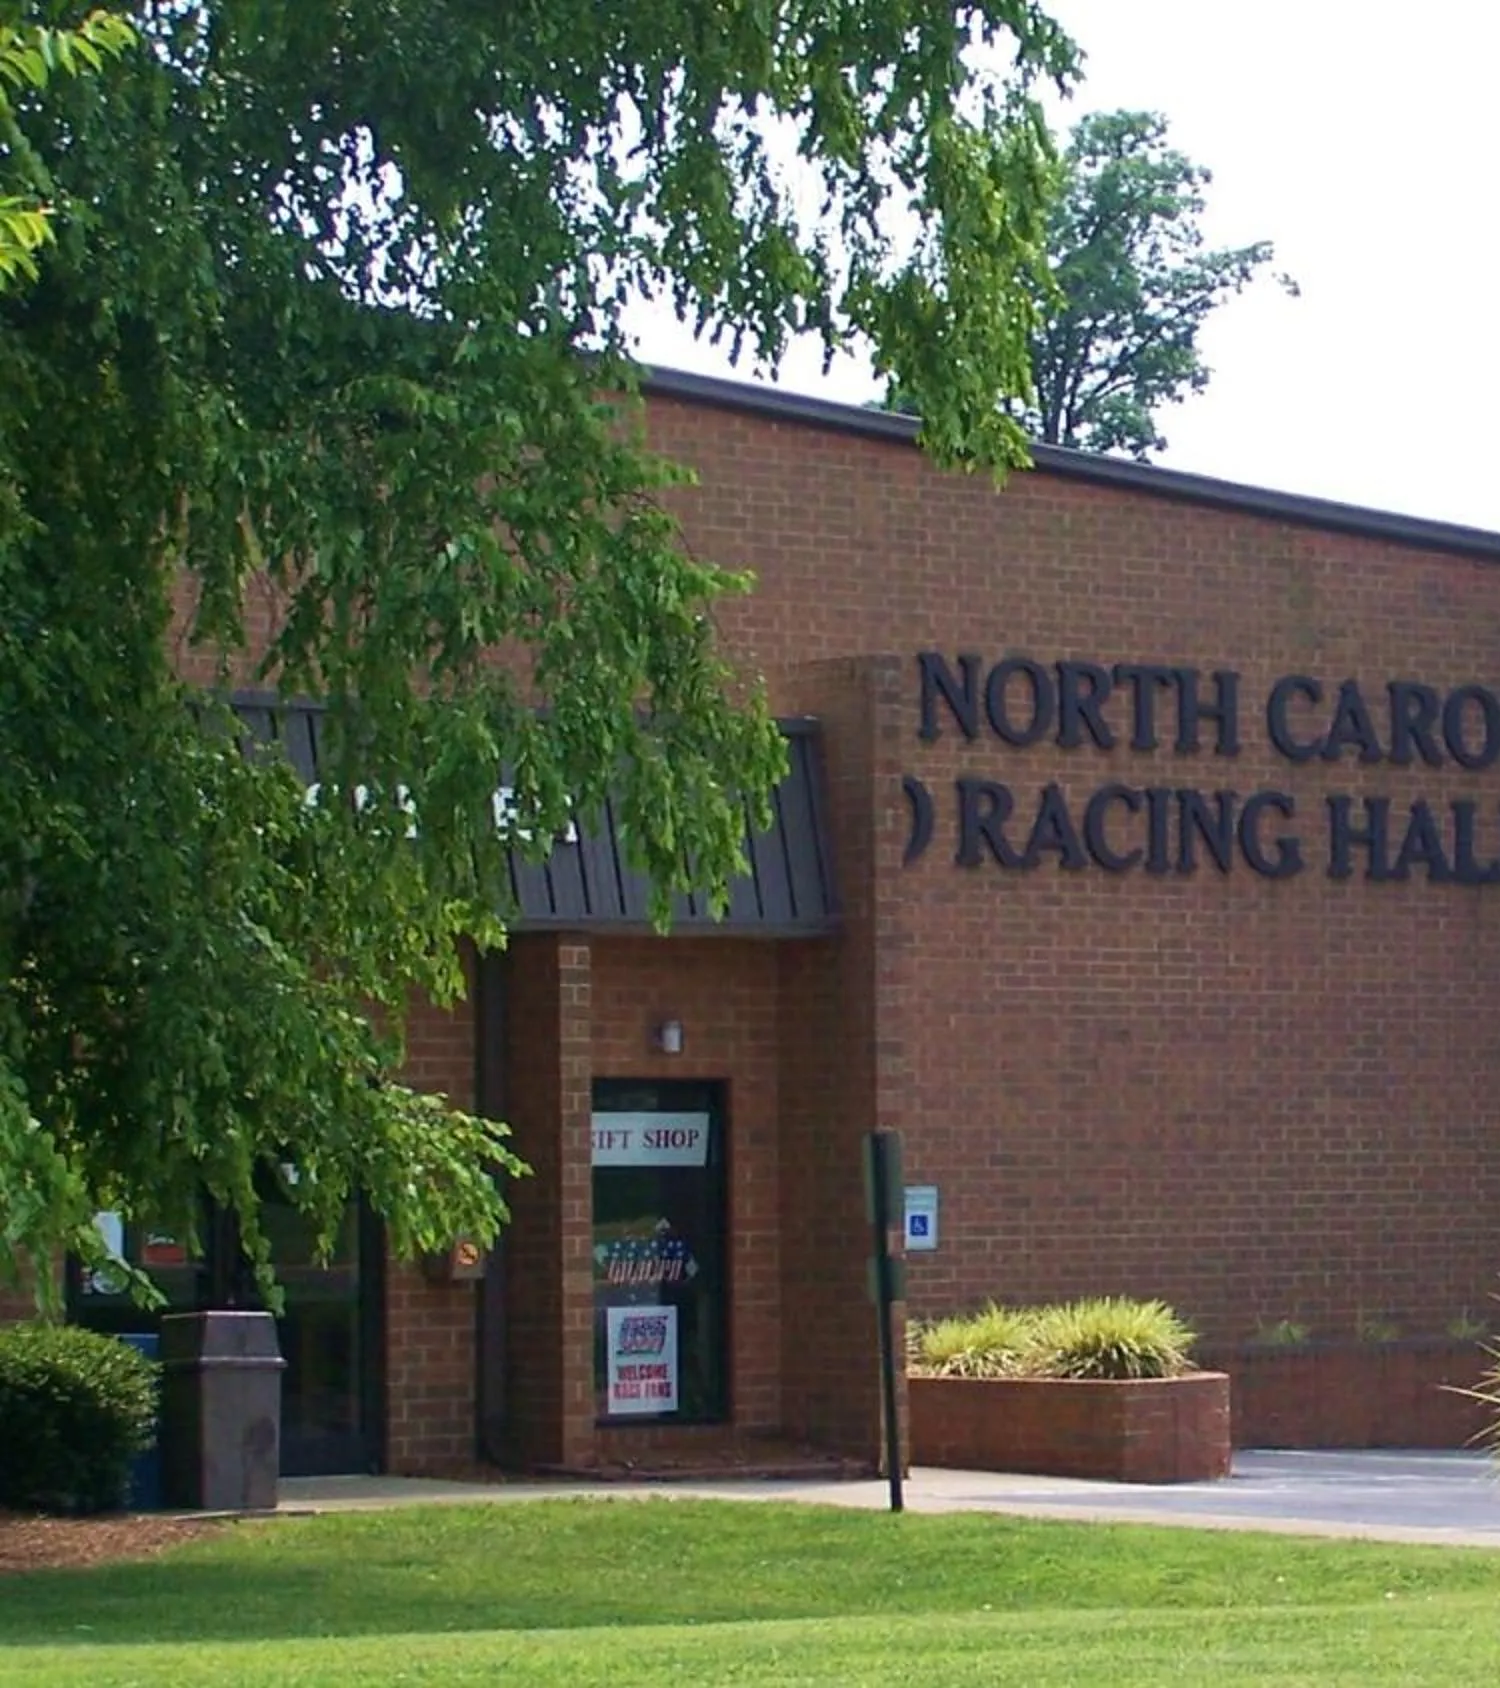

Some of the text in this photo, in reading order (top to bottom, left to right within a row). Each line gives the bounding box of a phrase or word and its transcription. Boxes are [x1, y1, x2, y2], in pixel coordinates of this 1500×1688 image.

[917, 652, 1241, 757] NORTH
[955, 779, 1305, 880] RACING
[642, 1128, 700, 1149] SHOP
